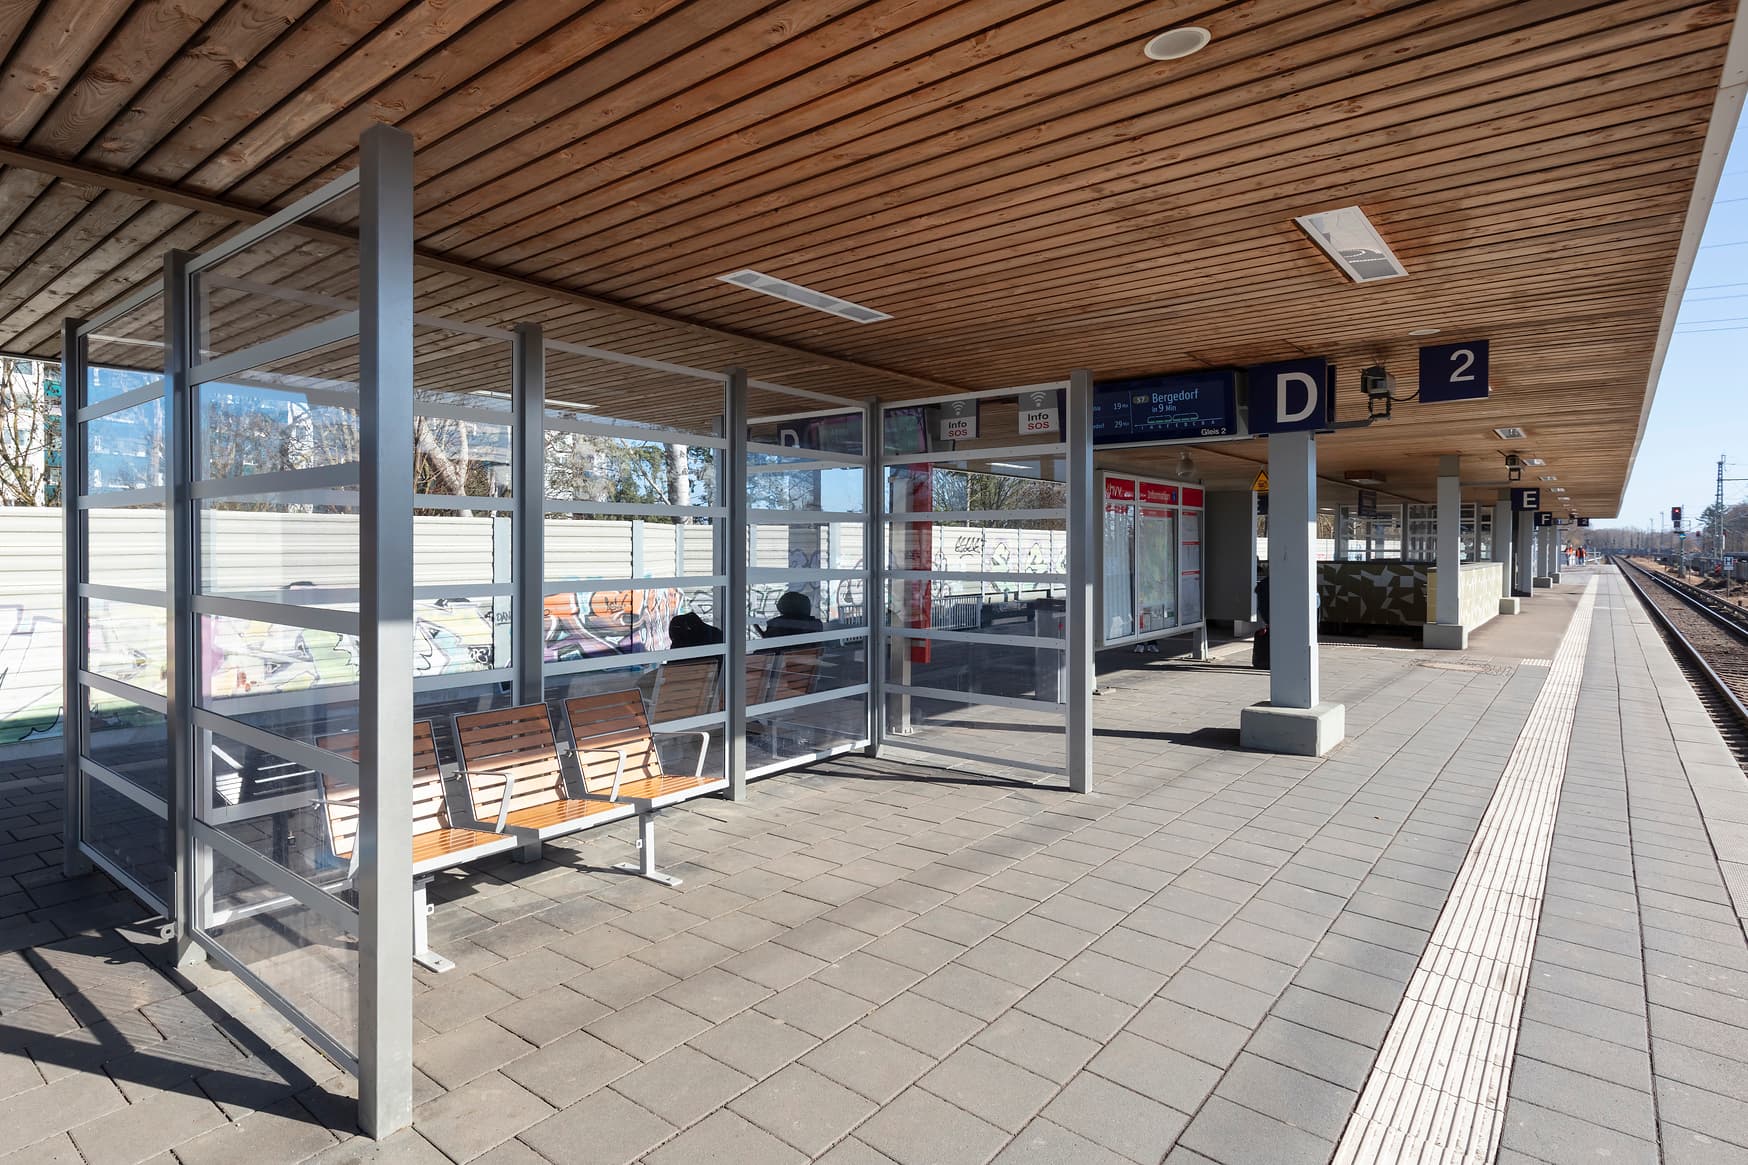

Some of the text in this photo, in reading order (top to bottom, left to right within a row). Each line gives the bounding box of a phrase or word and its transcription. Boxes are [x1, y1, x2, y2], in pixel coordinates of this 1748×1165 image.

[1450, 349, 1475, 383] 2
[1151, 388, 1199, 404] Bergedorf
[1276, 371, 1318, 424] D
[1158, 403, 1164, 412] 9
[1165, 404, 1177, 412] Min
[1027, 412, 1049, 422] Info
[948, 420, 968, 429] Info
[1027, 421, 1050, 431] SOS
[948, 428, 968, 437] SOS
[1201, 428, 1220, 436] Gleis
[1523, 491, 1537, 508] E
[1541, 513, 1551, 525] F
